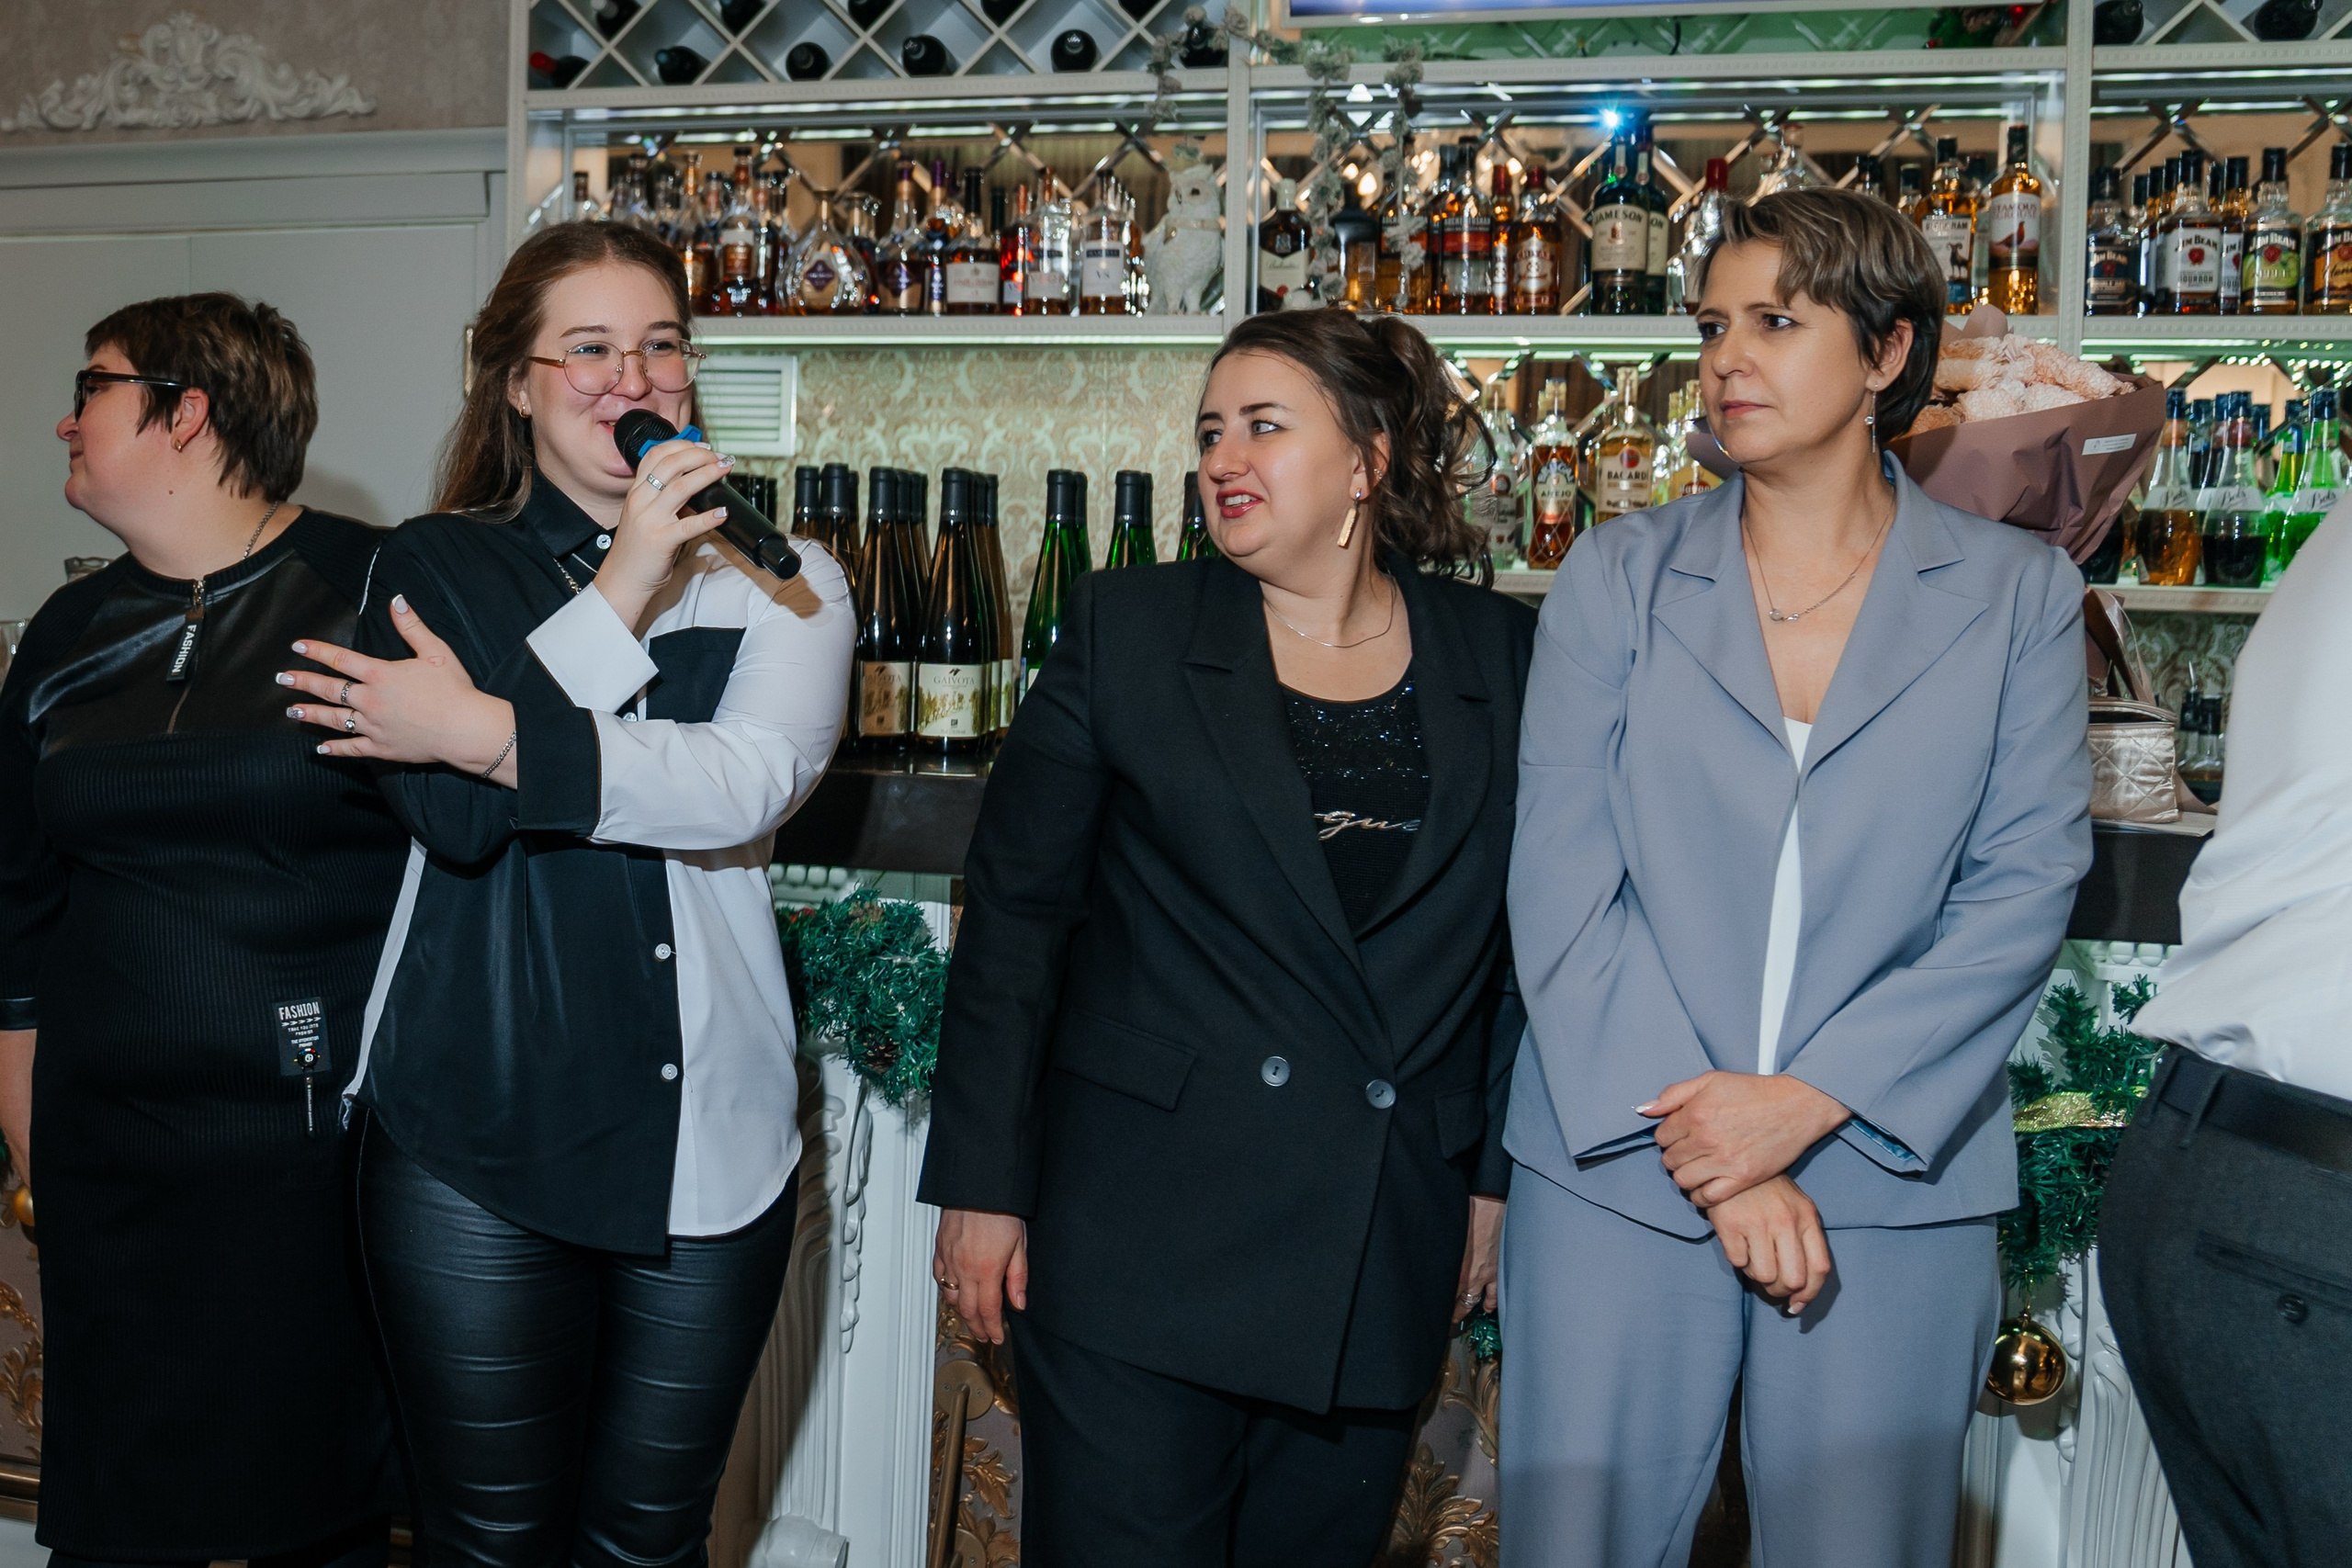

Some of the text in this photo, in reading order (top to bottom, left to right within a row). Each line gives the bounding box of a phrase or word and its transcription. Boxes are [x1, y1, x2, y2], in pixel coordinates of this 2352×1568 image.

[1594, 208, 1643, 225] JAMESON
[2175, 234, 2218, 253] JIM BEAM
[2247, 231, 2296, 253] JIM BEAM
[1607, 470, 1648, 480] BACARDI
[2221, 490, 2247, 507] Bols
[2307, 490, 2337, 510] Bols
[172, 625, 197, 672] FASHION
[933, 676, 975, 684] GAIVOTA
[278, 1001, 320, 1020] FASHION
